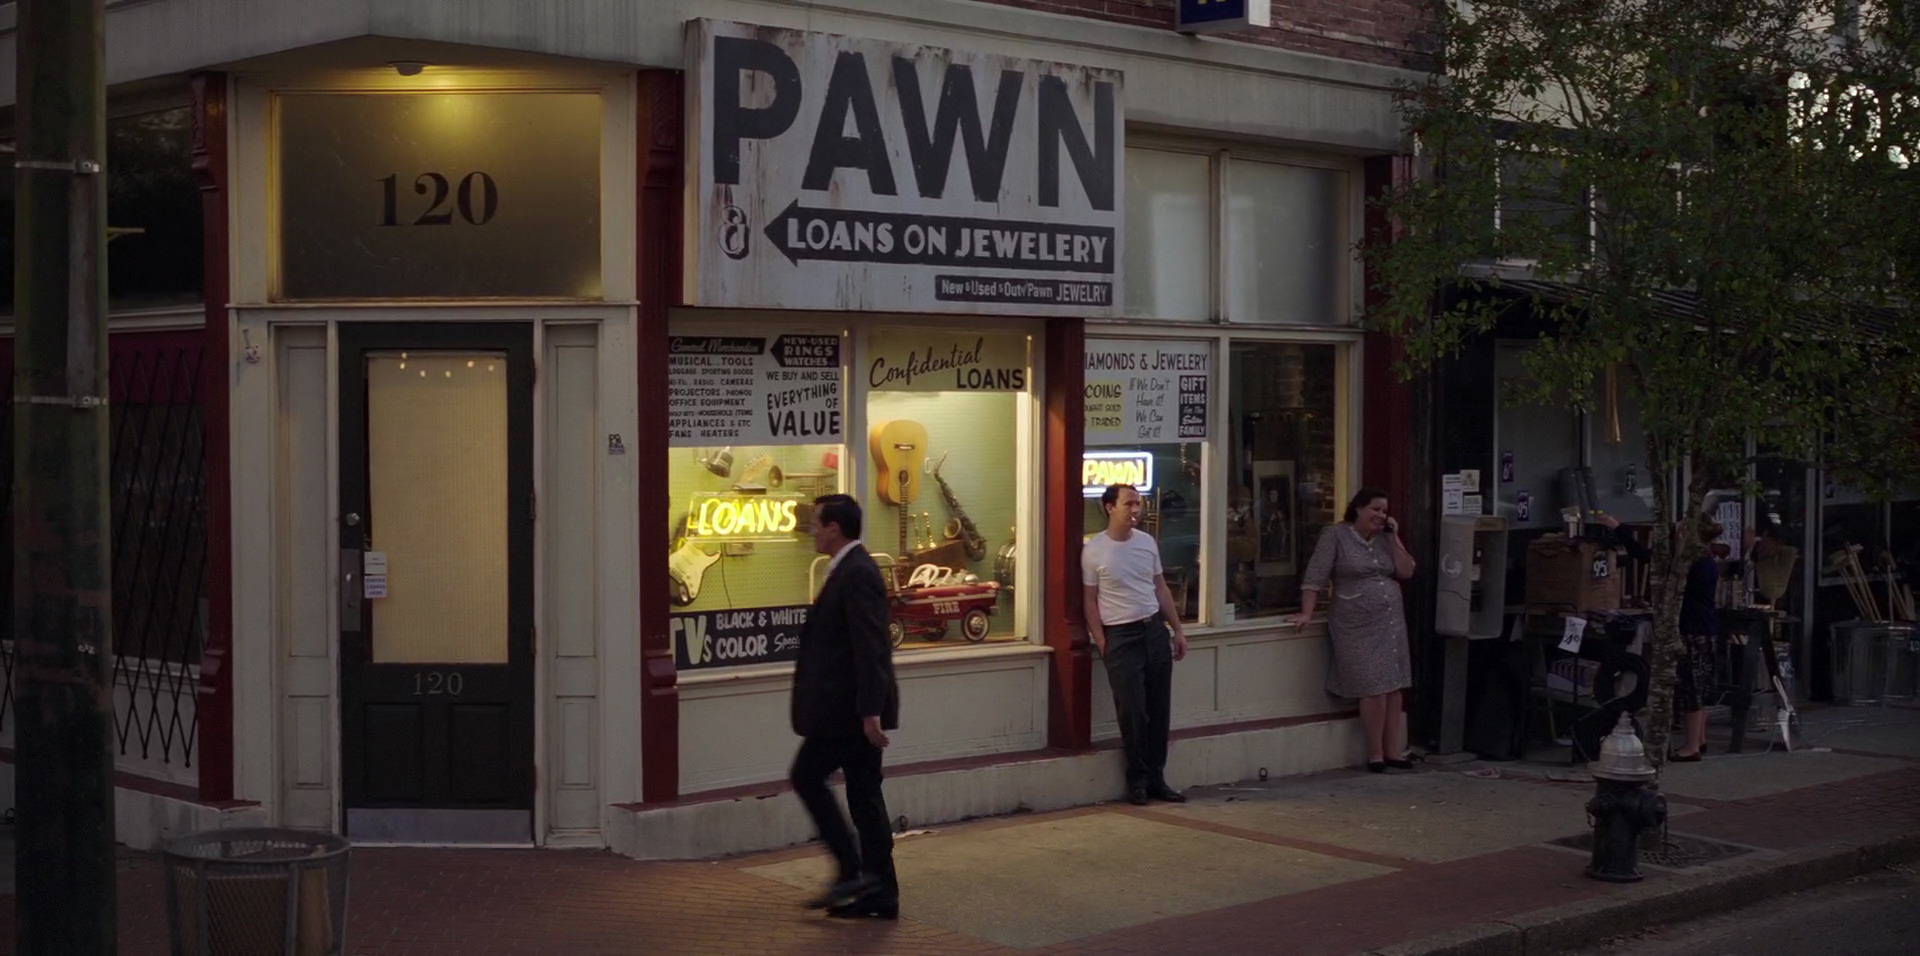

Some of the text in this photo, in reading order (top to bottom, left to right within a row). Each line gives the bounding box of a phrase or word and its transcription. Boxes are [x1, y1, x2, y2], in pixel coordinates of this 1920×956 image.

[713, 36, 1115, 211] PAWN
[376, 171, 498, 226] 120
[719, 205, 750, 260] &
[787, 218, 1108, 263] LOANS ON JEWELERY
[941, 279, 965, 295] New
[971, 281, 997, 297] Used
[1056, 283, 1108, 303] JEWELRY
[784, 345, 834, 357] RINGS
[785, 357, 829, 367] WATCHES
[870, 336, 984, 388] Confidential
[1084, 352, 1136, 370] IAMONDS
[1139, 353, 1149, 370] &
[766, 371, 840, 381] WE BUY AND SELL
[956, 368, 1025, 390] LOANS
[1180, 376, 1206, 392] GIFT
[669, 389, 721, 397] PROJECTORS
[767, 382, 838, 411] EVERYTHING
[1084, 384, 1122, 398] COINS
[1180, 392, 1206, 405] ITEMS
[669, 398, 745, 407] OFFICE EQUIPMENT
[825, 398, 840, 410] OF
[669, 429, 741, 439] FANS HEATERS
[670, 419, 726, 429] APPLIANCES
[768, 410, 841, 437] VALUE
[1083, 459, 1144, 486] PAWN
[697, 499, 798, 536] LOANS
[715, 608, 809, 630] BLACK & WHITE
[932, 601, 961, 616] FIRE
[715, 634, 769, 660] COLOR
[412, 670, 464, 697] 120
